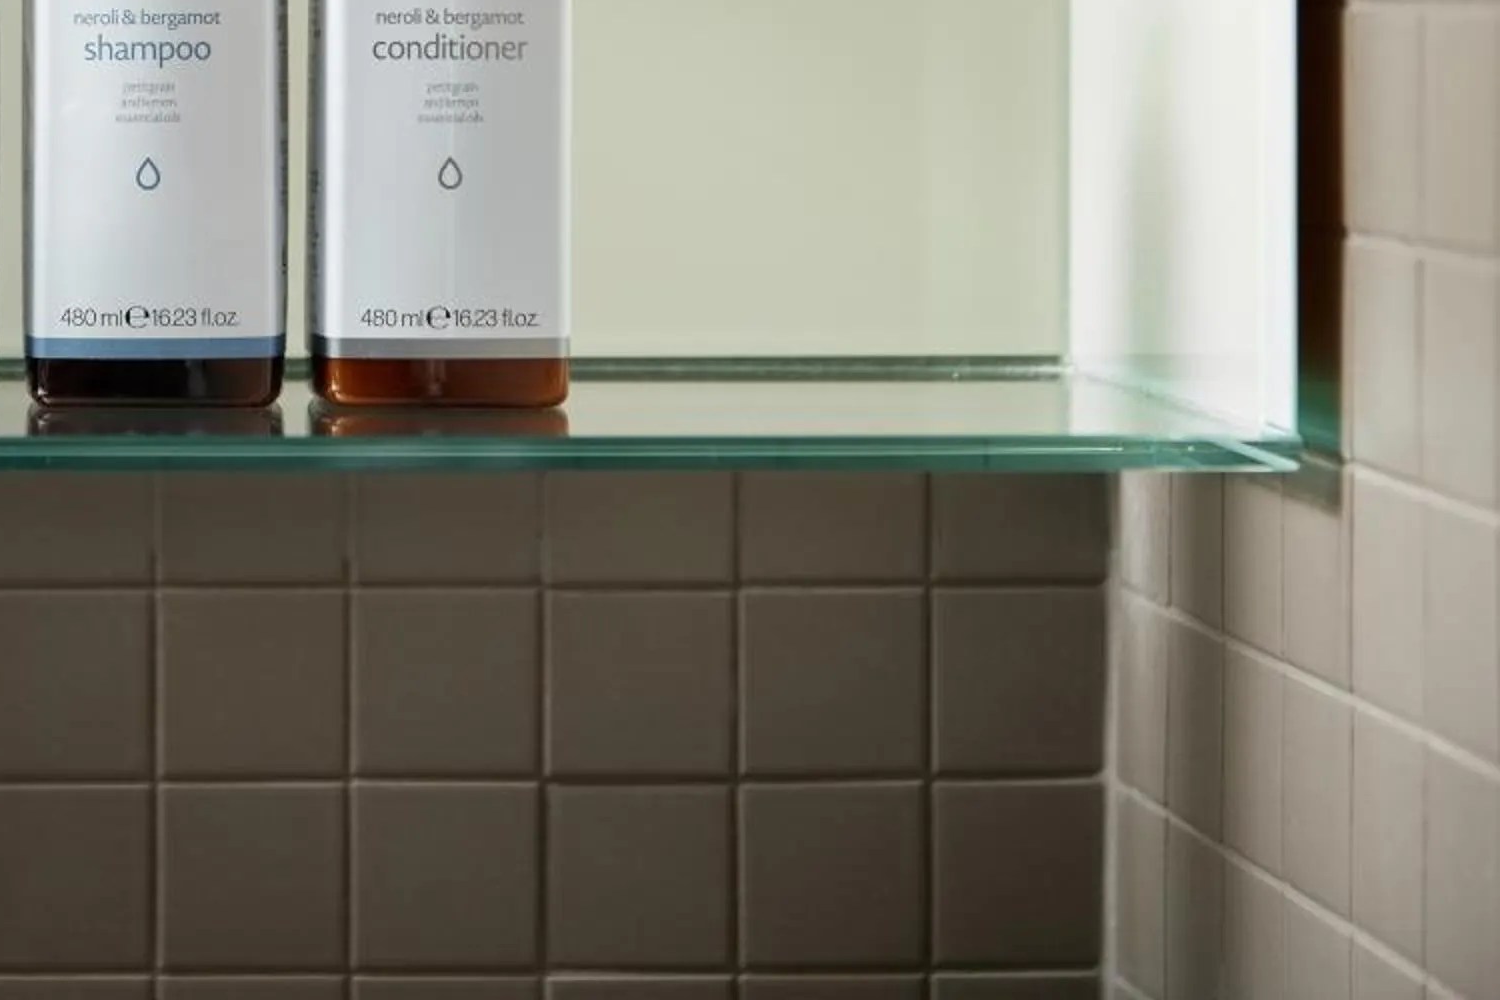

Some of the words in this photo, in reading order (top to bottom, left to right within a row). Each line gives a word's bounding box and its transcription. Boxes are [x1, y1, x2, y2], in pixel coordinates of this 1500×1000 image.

[73, 8, 119, 25] neroli
[121, 9, 137, 25] &
[140, 8, 222, 31] bergamot
[375, 8, 422, 25] neroli
[425, 8, 441, 25] &
[443, 8, 525, 31] bergamot
[84, 33, 212, 69] shampoo
[372, 32, 529, 61] conditioner
[60, 307, 97, 327] 480
[100, 308, 123, 327] ml
[360, 308, 398, 327] 480
[401, 308, 424, 327] ml
